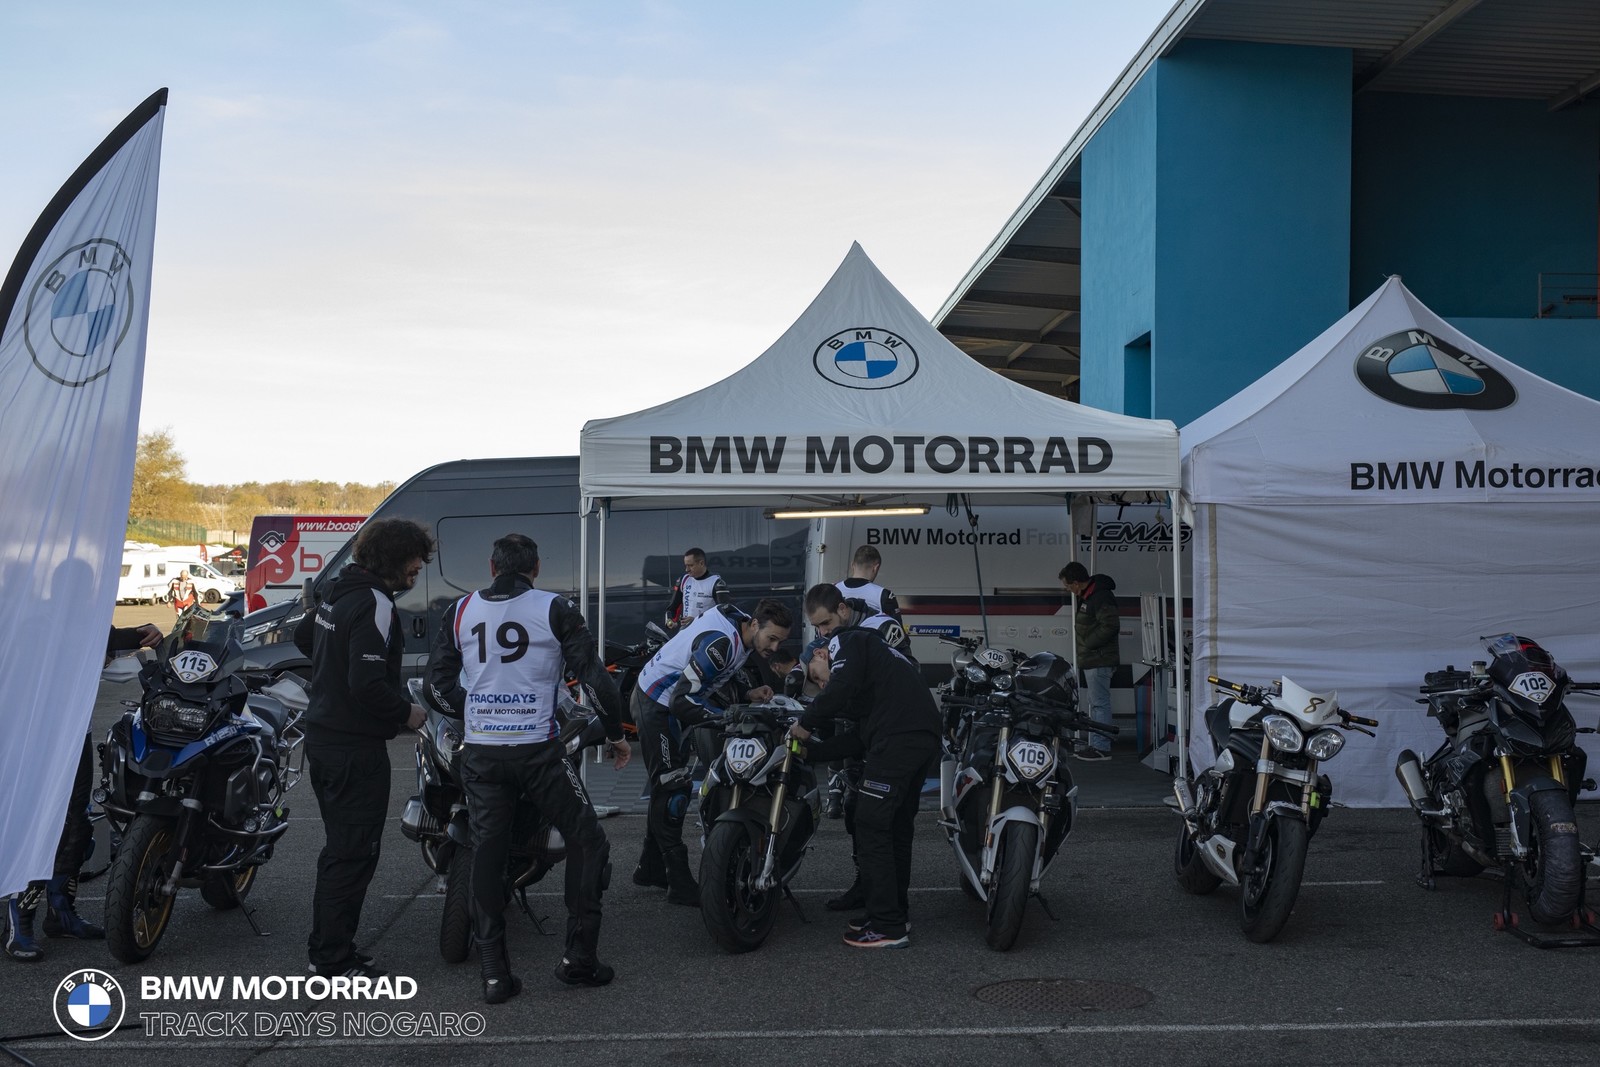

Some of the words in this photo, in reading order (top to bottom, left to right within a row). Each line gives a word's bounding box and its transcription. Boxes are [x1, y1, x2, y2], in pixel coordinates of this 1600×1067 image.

[827, 331, 902, 350] BMW
[1365, 331, 1488, 370] BMW
[650, 436, 787, 474] BMW
[805, 435, 1114, 474] MOTORRAD
[1350, 461, 1445, 491] BMW
[296, 520, 364, 531] www.boost
[866, 528, 921, 545] BMW
[927, 528, 1021, 545] Motorrad
[1026, 529, 1071, 545] Fran
[471, 621, 530, 664] 19
[180, 656, 208, 672] 115
[987, 652, 1004, 662] 106
[1519, 677, 1549, 692] 102
[469, 694, 536, 704] TRACKDAYS
[659, 733, 672, 769] RST
[731, 744, 756, 759] 110
[1019, 748, 1046, 766] 109
[561, 758, 588, 805] RST
